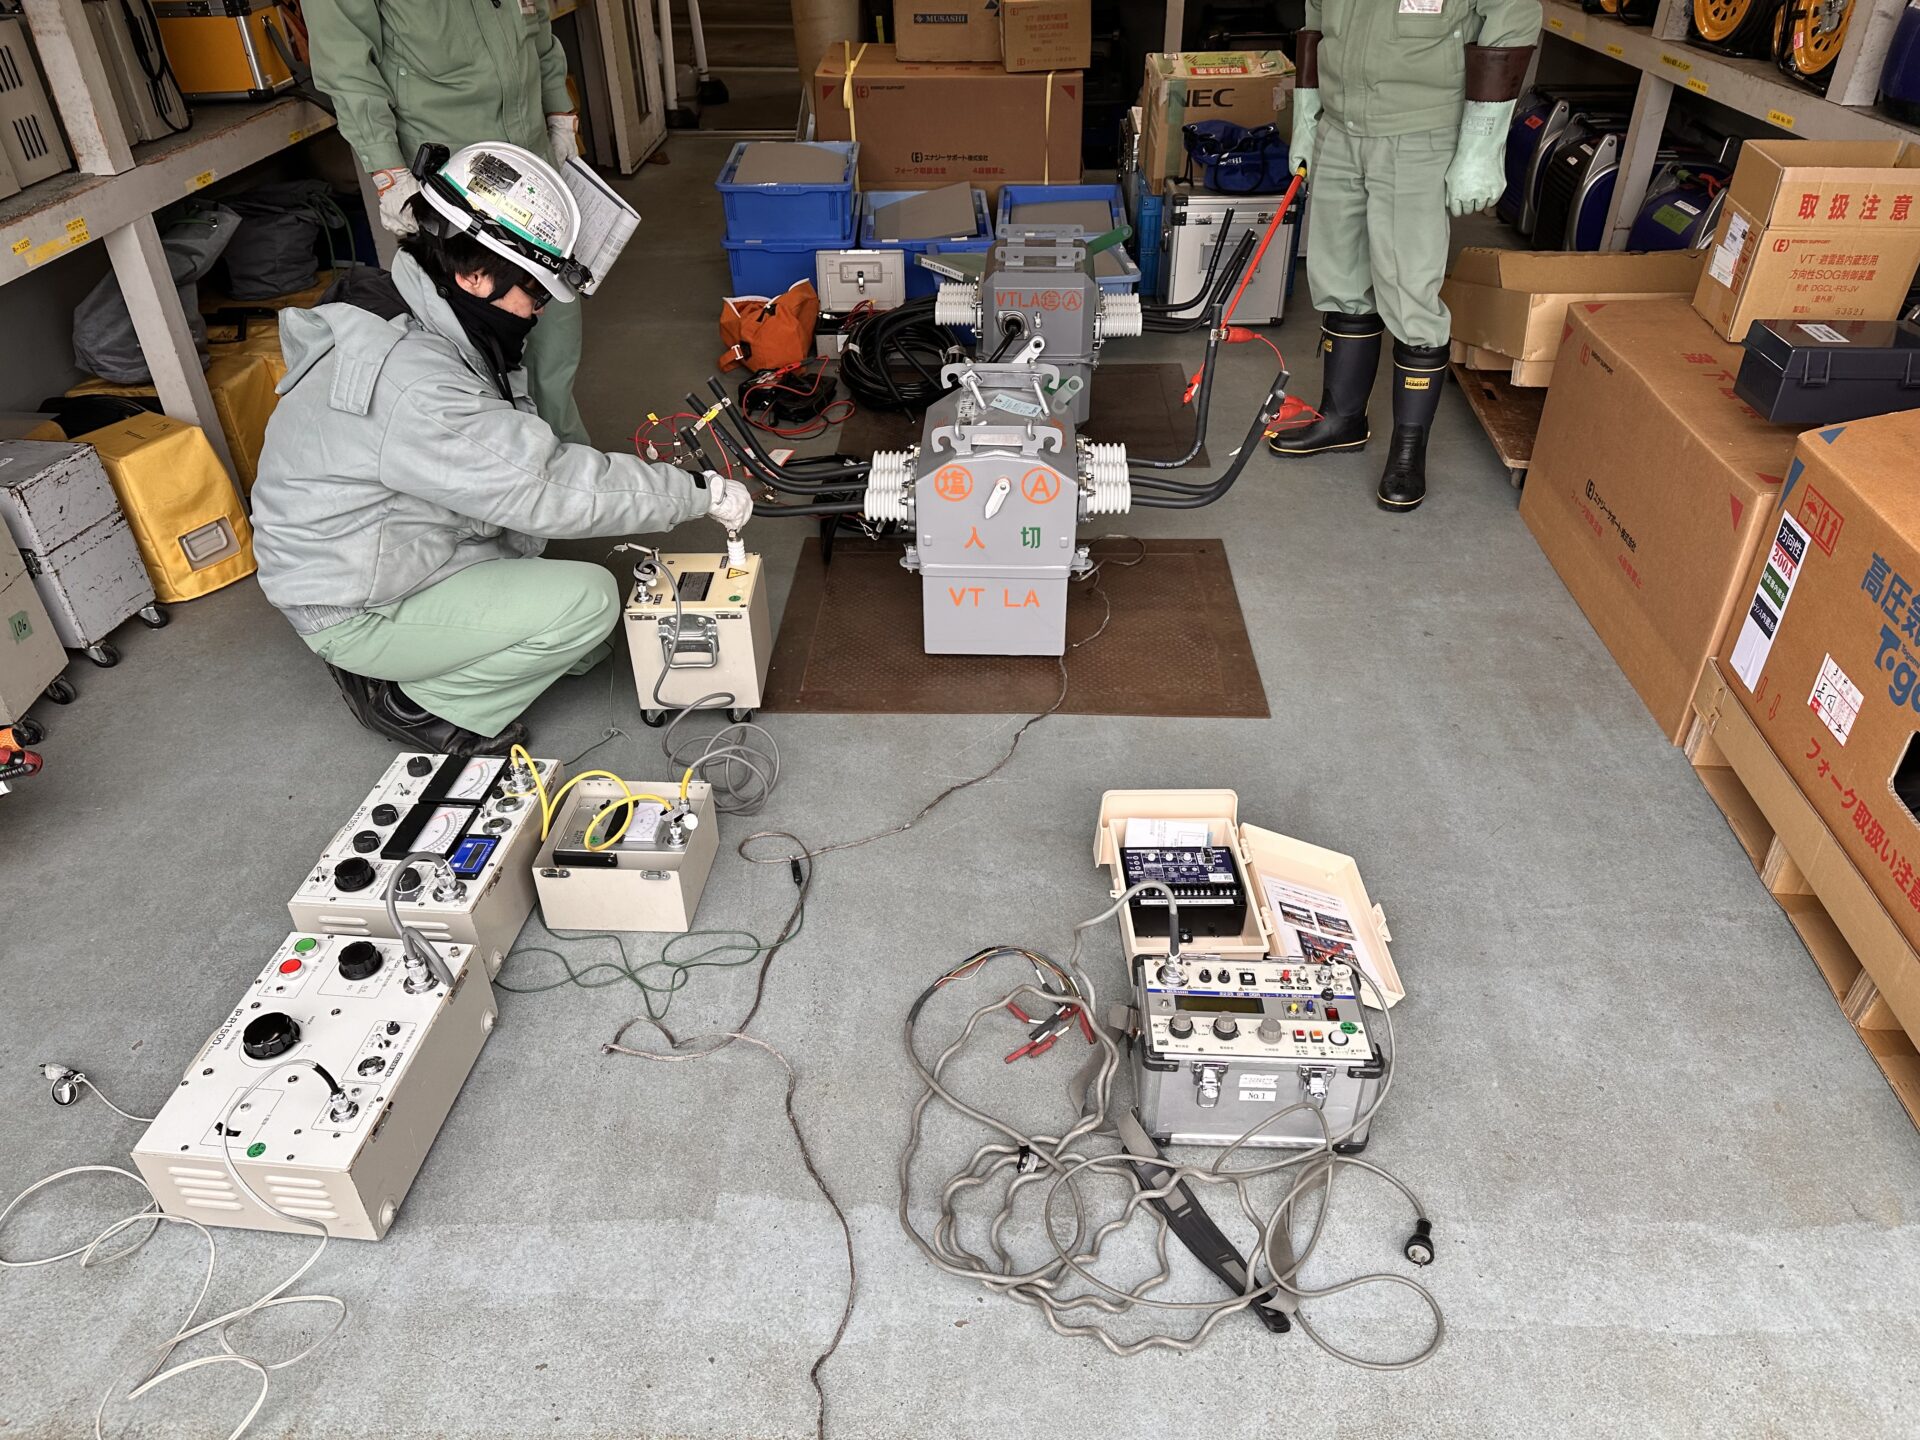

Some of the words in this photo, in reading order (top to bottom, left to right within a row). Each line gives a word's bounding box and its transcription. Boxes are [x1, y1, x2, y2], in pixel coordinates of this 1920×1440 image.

[926, 15, 965, 23] MUSASHI
[1167, 88, 1235, 107] NEC
[1798, 193, 1912, 221] 取扱注意
[1789, 269, 1876, 281] 方向性SOG制御装置
[938, 467, 970, 498] 塩
[1021, 526, 1041, 549] 切
[1779, 526, 1801, 560] 方向性
[1772, 547, 1793, 581] 200A
[948, 587, 985, 607] VT
[1004, 588, 1041, 608] LA
[212, 1008, 245, 1046] IP-R1500
